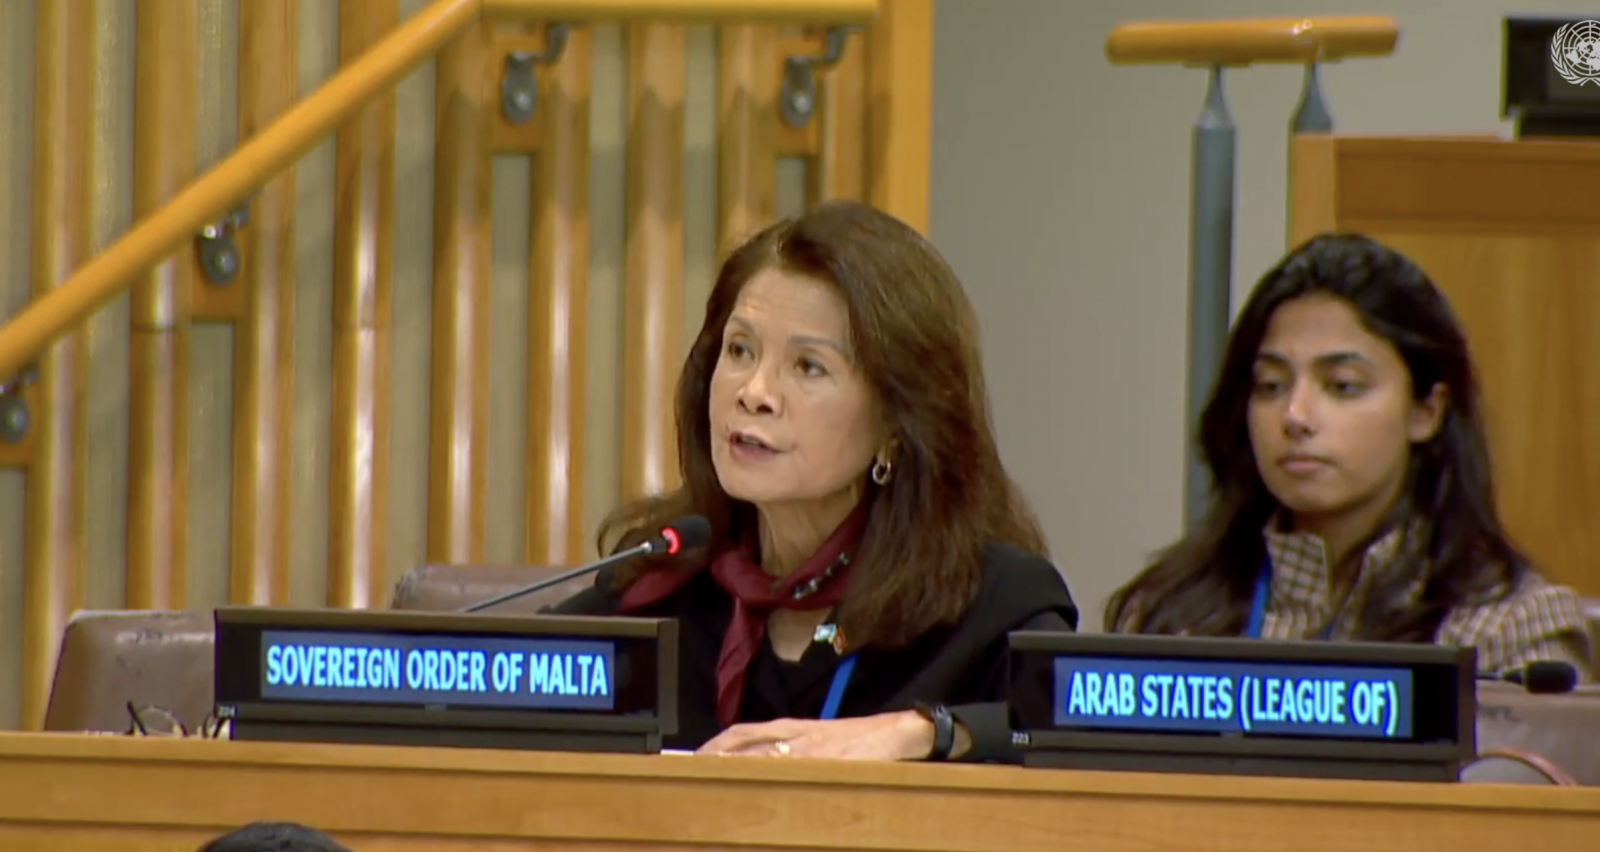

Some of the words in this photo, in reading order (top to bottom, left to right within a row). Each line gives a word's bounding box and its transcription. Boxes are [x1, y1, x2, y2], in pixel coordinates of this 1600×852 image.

[267, 645, 401, 688] SOVEREIGN
[406, 649, 487, 692] ORDER
[492, 652, 524, 693] OF
[529, 653, 609, 696] MALTA
[1069, 672, 1136, 717] ARAB
[1141, 675, 1234, 719] STATES
[1240, 676, 1347, 731] (LEAGUE
[1352, 681, 1399, 736] OF)
